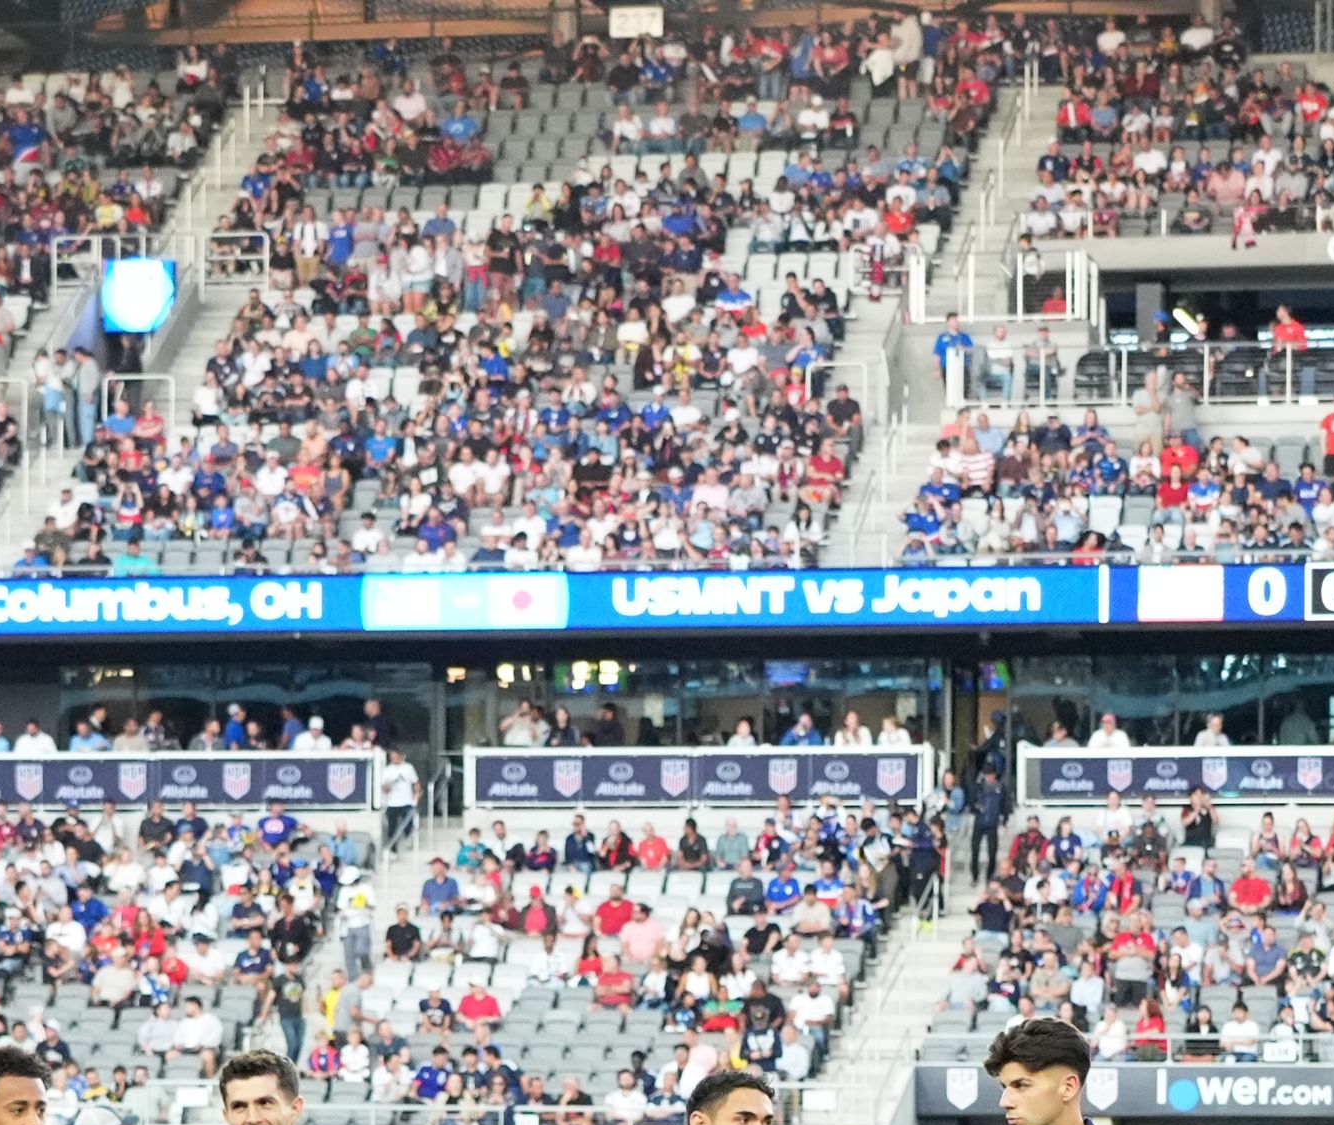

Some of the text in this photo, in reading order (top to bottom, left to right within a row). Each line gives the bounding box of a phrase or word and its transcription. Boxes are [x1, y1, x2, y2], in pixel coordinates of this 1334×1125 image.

[249, 582, 323, 620] OH
[612, 575, 1041, 618] USMNT vs Japan
[1247, 565, 1287, 616] 0
